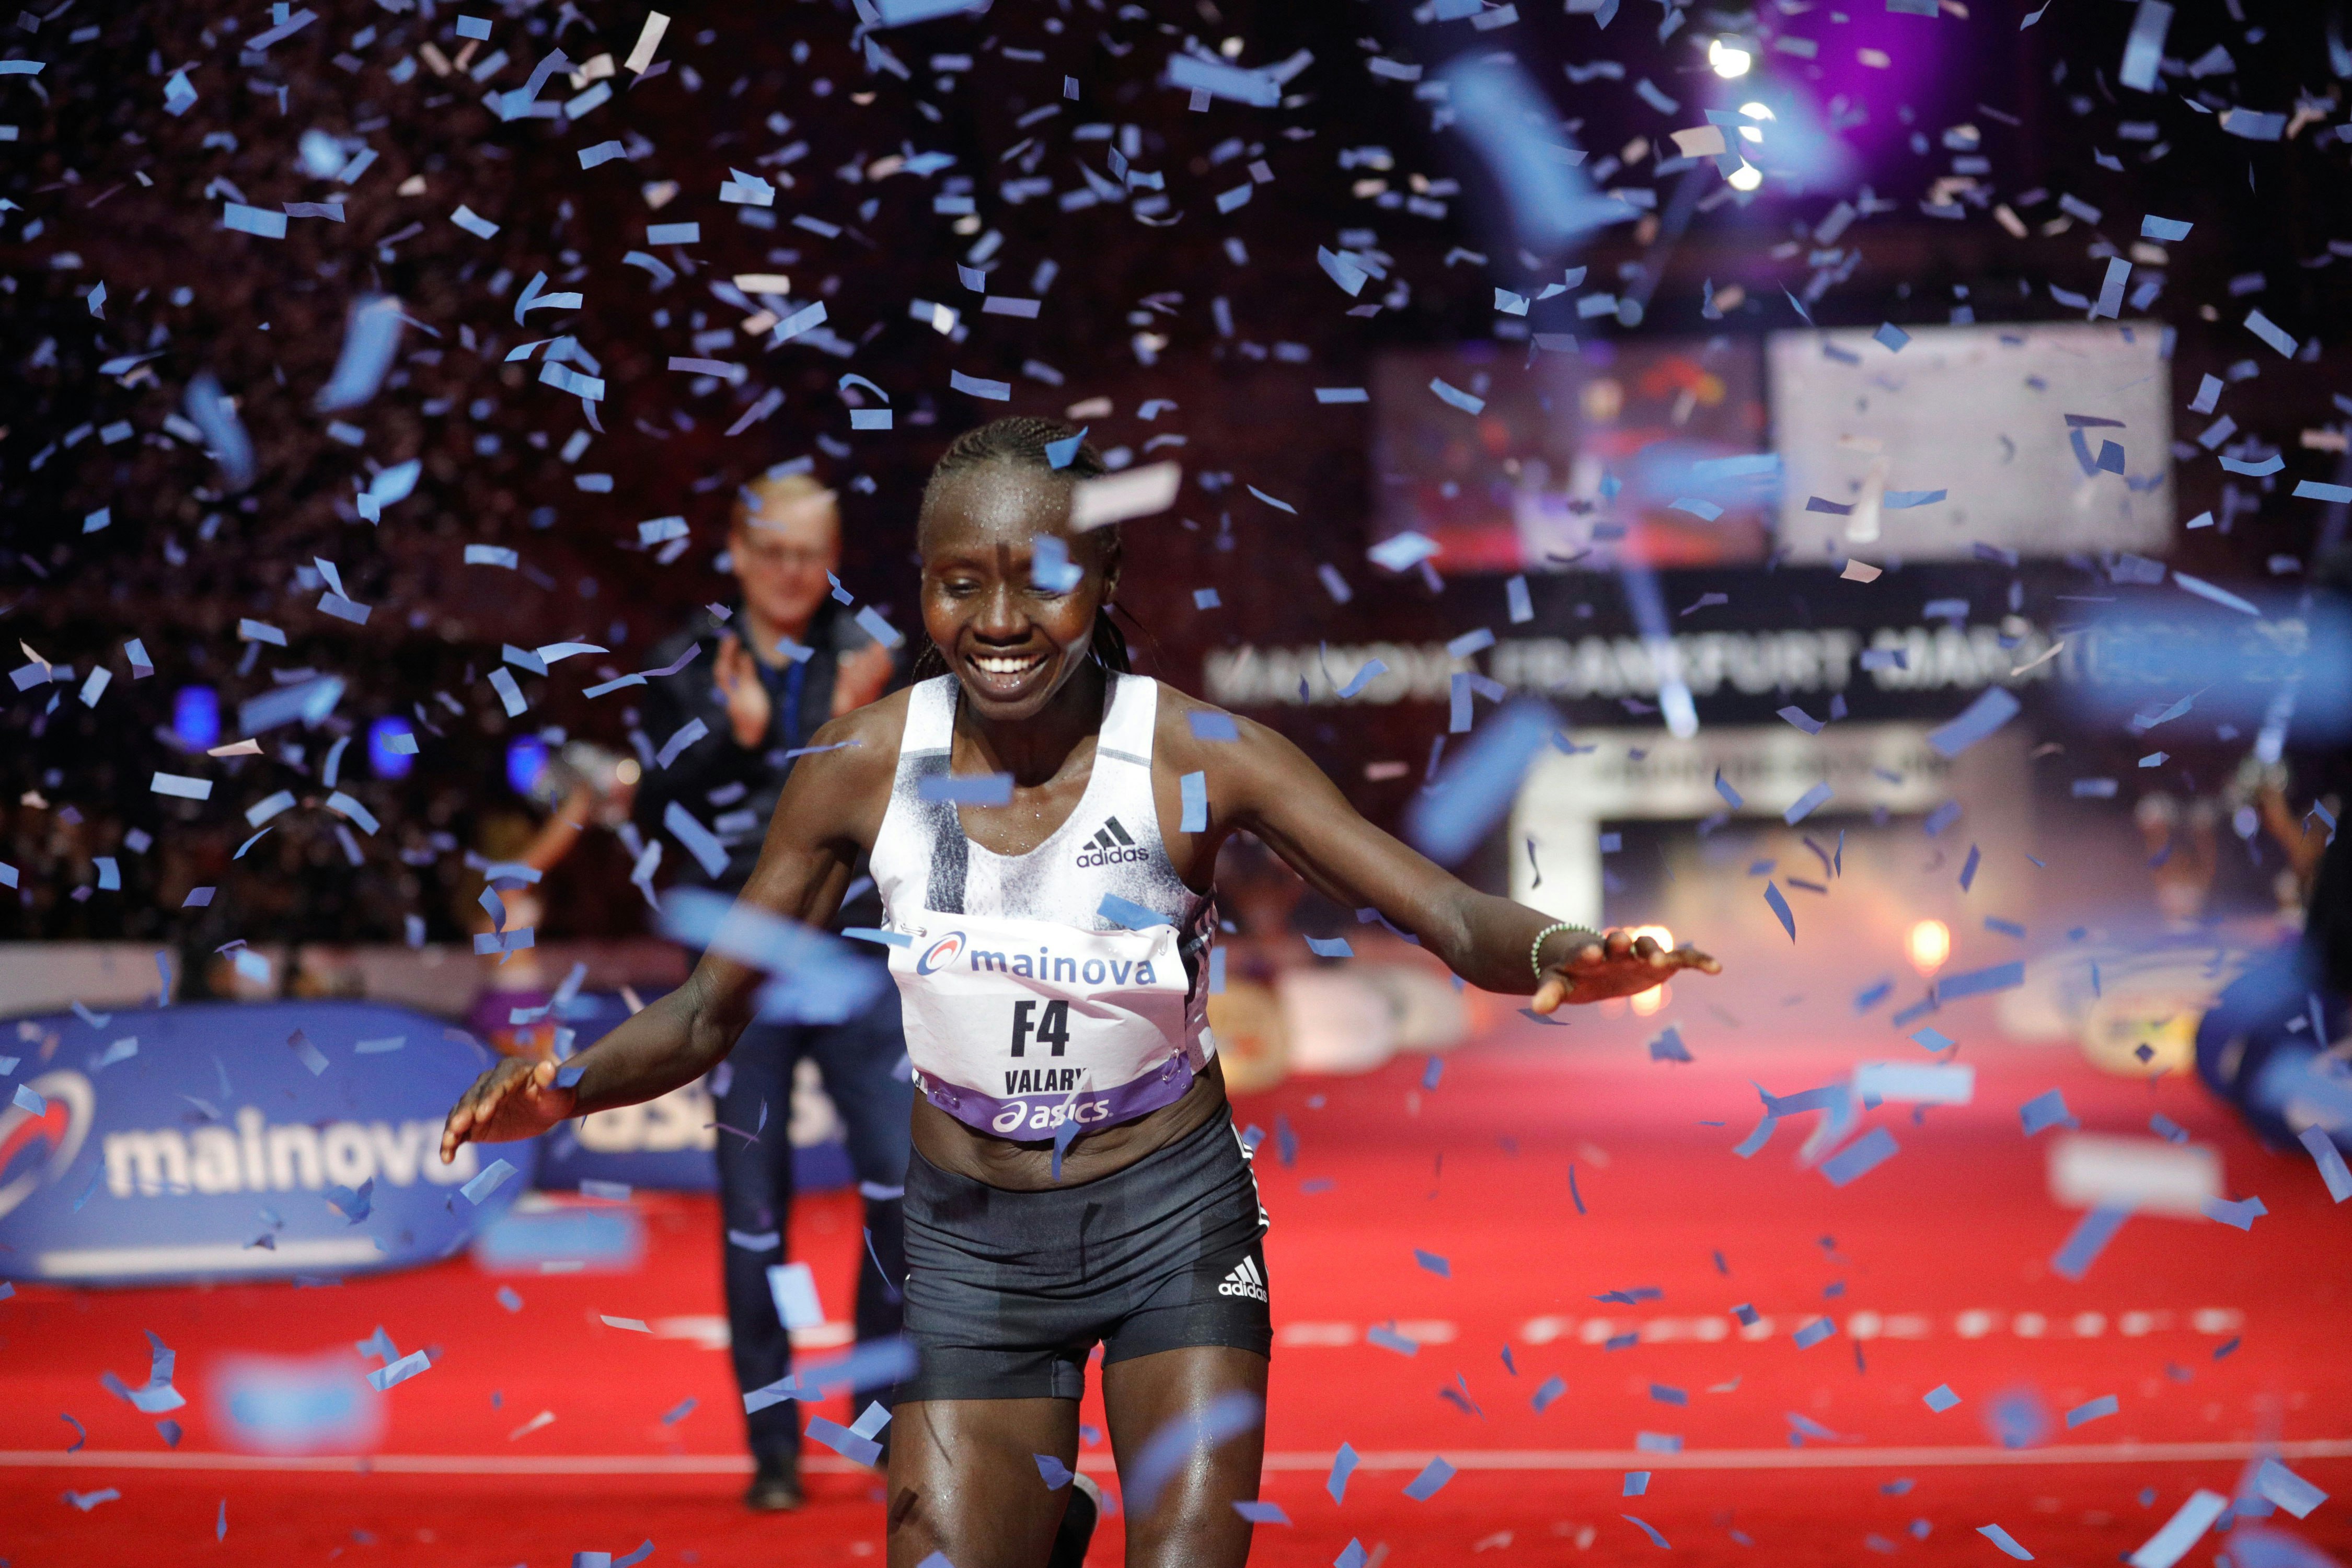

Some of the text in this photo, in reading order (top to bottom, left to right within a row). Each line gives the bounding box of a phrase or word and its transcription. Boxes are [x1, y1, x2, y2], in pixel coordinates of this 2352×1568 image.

[1076, 845, 1149, 868] adidas
[971, 947, 1157, 986] mainova
[1010, 999, 1070, 1057] F4
[1029, 1099, 1109, 1129] asics
[106, 1106, 478, 1198] mainova
[1218, 1281, 1267, 1303] adidas
